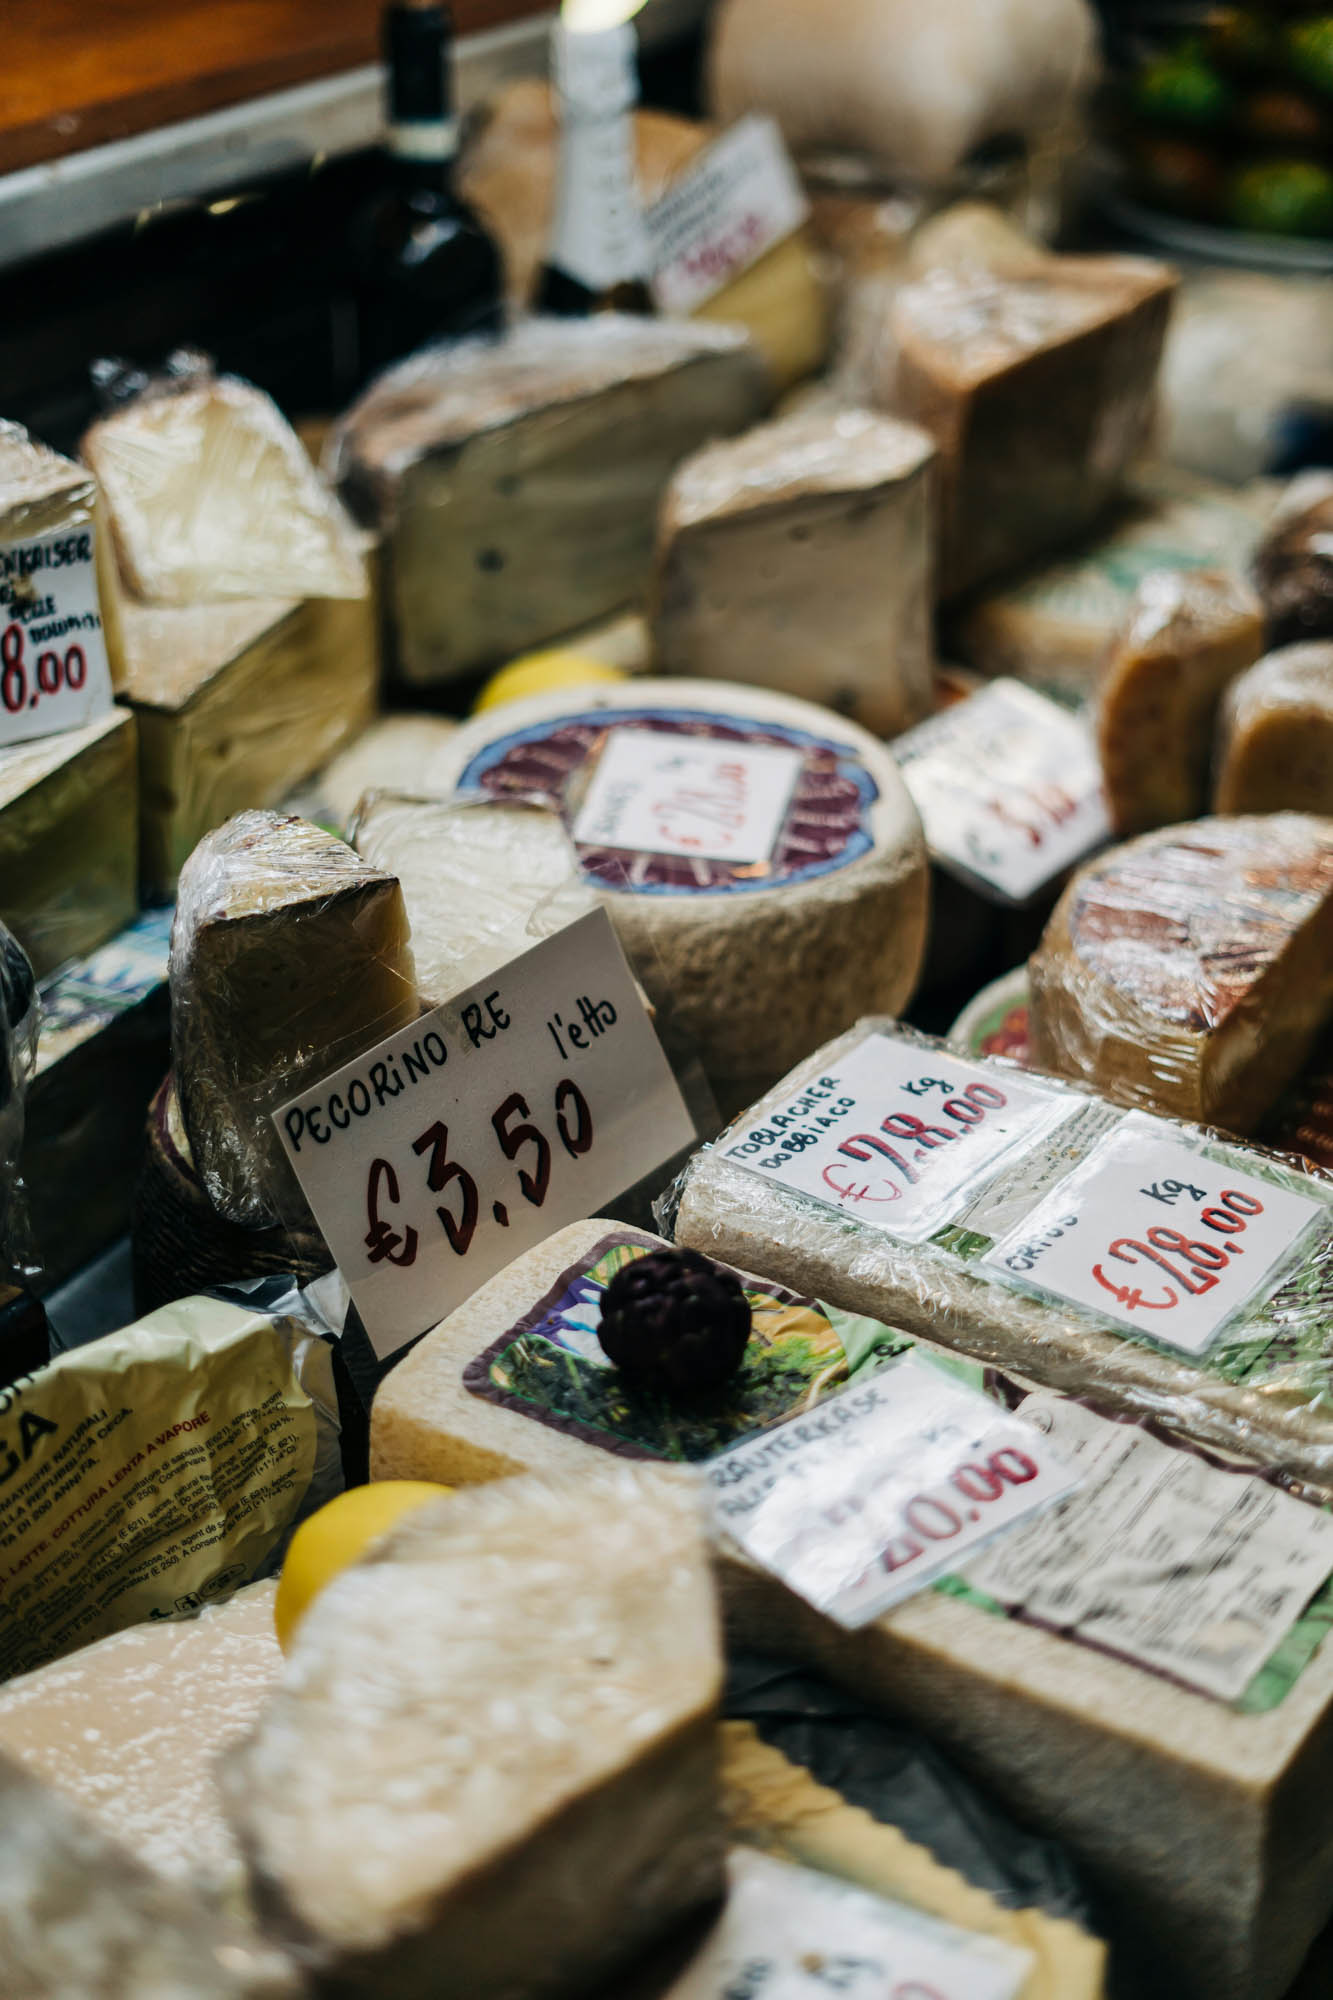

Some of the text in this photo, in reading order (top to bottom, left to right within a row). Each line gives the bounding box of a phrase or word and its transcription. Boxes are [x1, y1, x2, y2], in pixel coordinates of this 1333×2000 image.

[0, 532, 92, 577] NKAISER
[461, 991, 511, 1048] RE
[725, 1076, 841, 1162] TOBLACHER
[52, 1485, 108, 1539] COTTURA
[107, 1450, 146, 1488] LENTA
[146, 1442, 159, 1456] A
[155, 1409, 212, 1446] VAPORE
[53, 1471, 83, 1502] ANNI
[180, 1529, 206, 1547] agent
[205, 1522, 218, 1535] de
